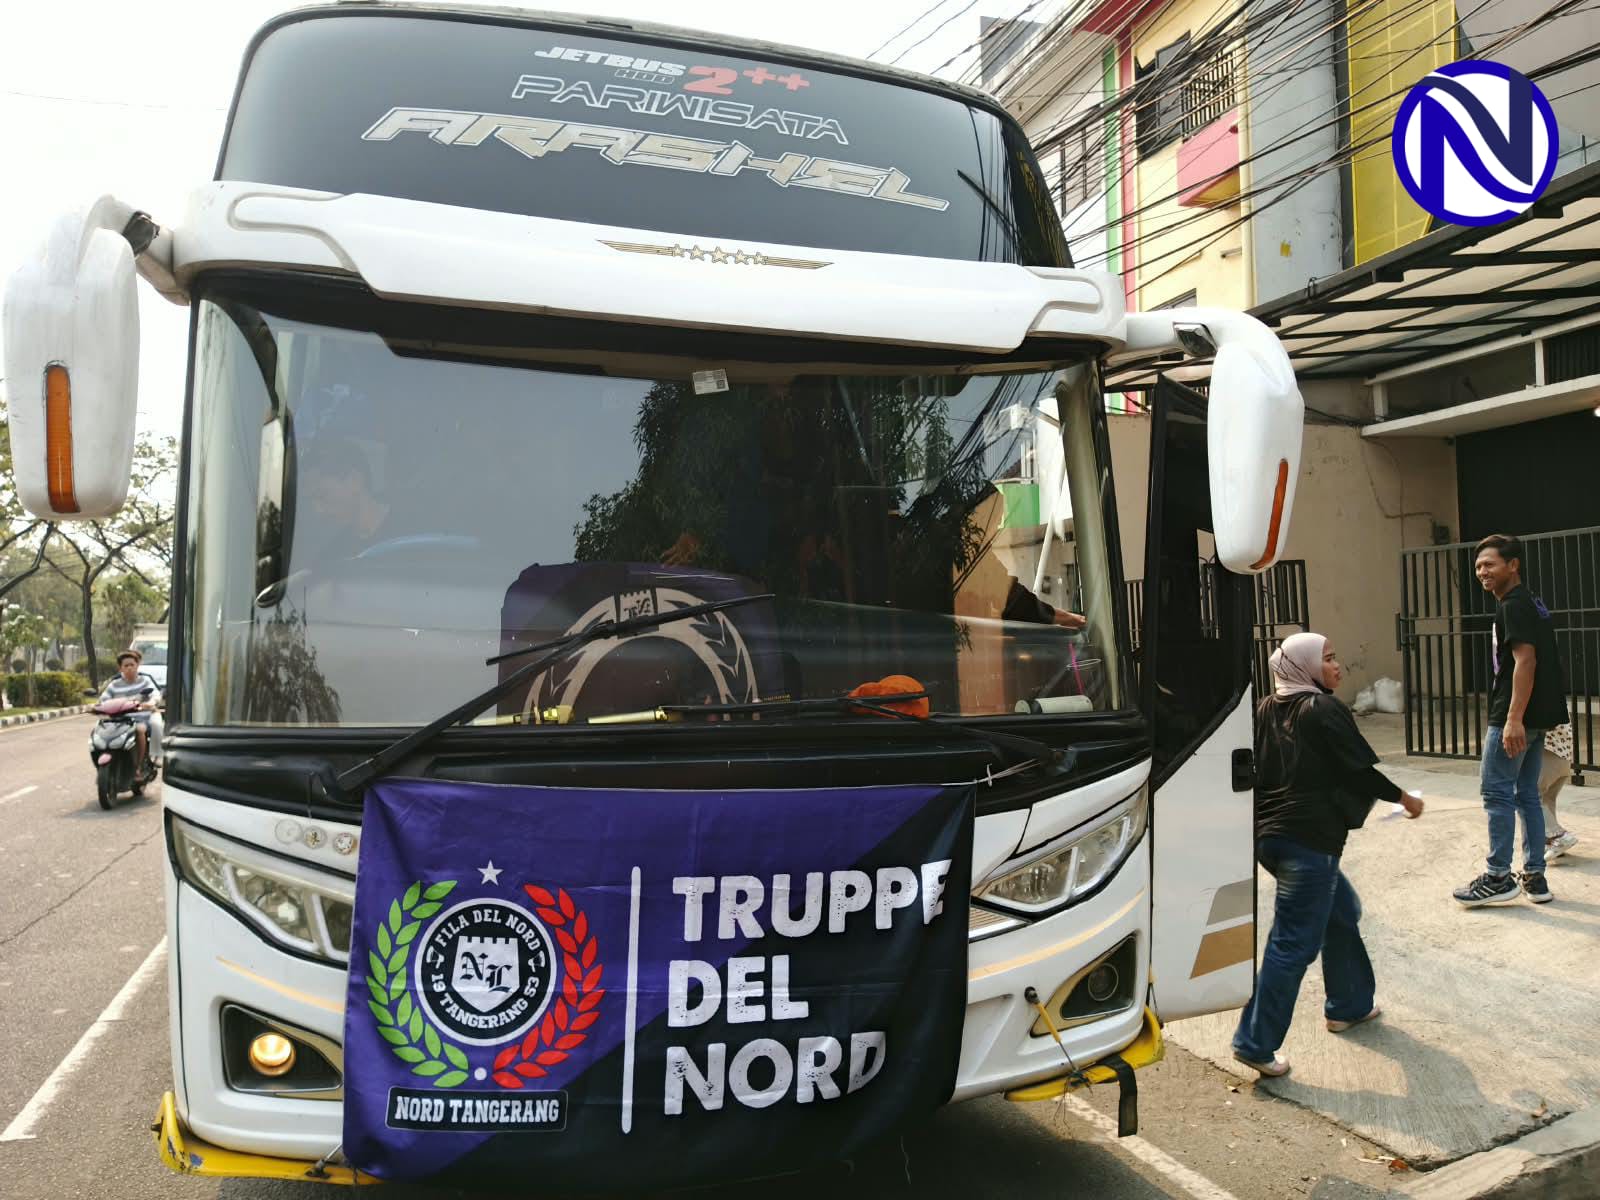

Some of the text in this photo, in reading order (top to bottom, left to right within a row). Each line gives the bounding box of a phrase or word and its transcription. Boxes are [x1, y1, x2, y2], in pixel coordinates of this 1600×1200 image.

[534, 46, 687, 76] JETBUS
[511, 74, 849, 145] PARIWISATA
[361, 106, 951, 212] ARASHEL
[434, 908, 541, 950] FILA DEL NORD
[672, 859, 952, 942] TRUPPE
[431, 973, 446, 993] 19
[440, 992, 529, 1029] TANGERANG
[667, 954, 809, 1028] DEL
[664, 1031, 887, 1115] NORD
[394, 1095, 560, 1123] NORD TANGERANG
